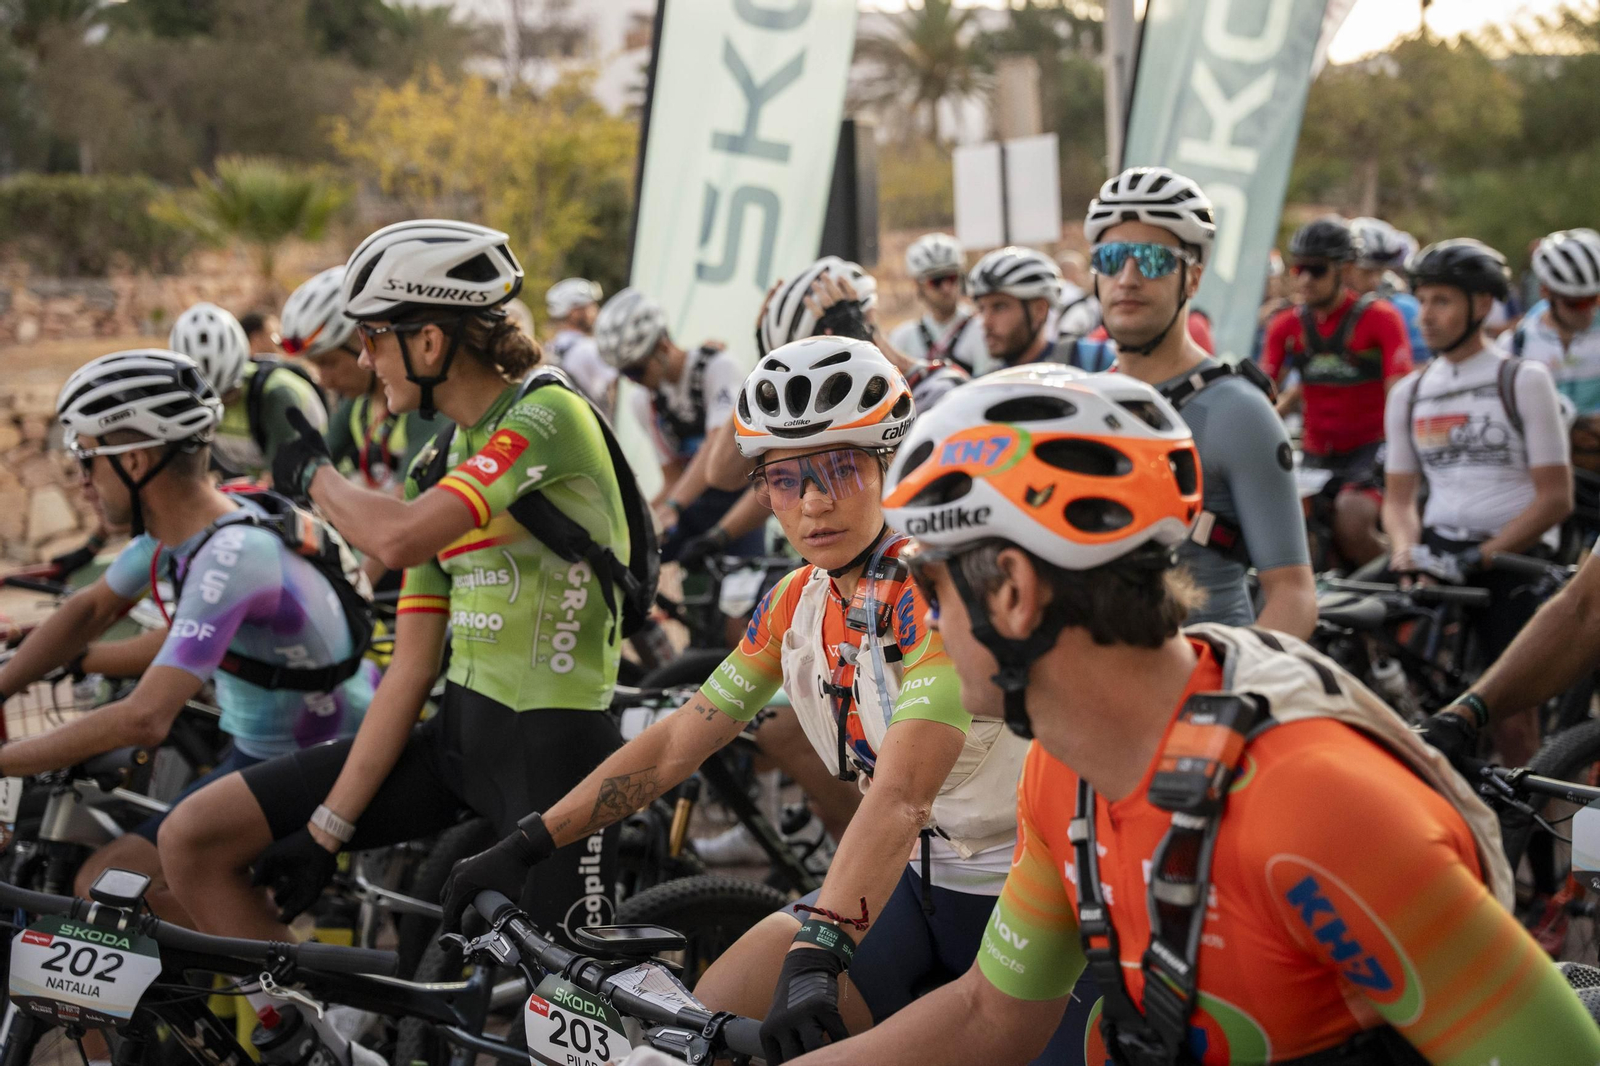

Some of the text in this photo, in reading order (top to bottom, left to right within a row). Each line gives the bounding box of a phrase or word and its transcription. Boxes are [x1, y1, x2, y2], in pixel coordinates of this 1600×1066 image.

[382, 279, 491, 302] S-WORKS
[783, 419, 811, 427] catlike
[905, 505, 992, 536] catlike
[171, 618, 216, 641] EDF
[41, 941, 124, 983] 202
[45, 976, 100, 998] NATALIA
[549, 1010, 610, 1062] 203
